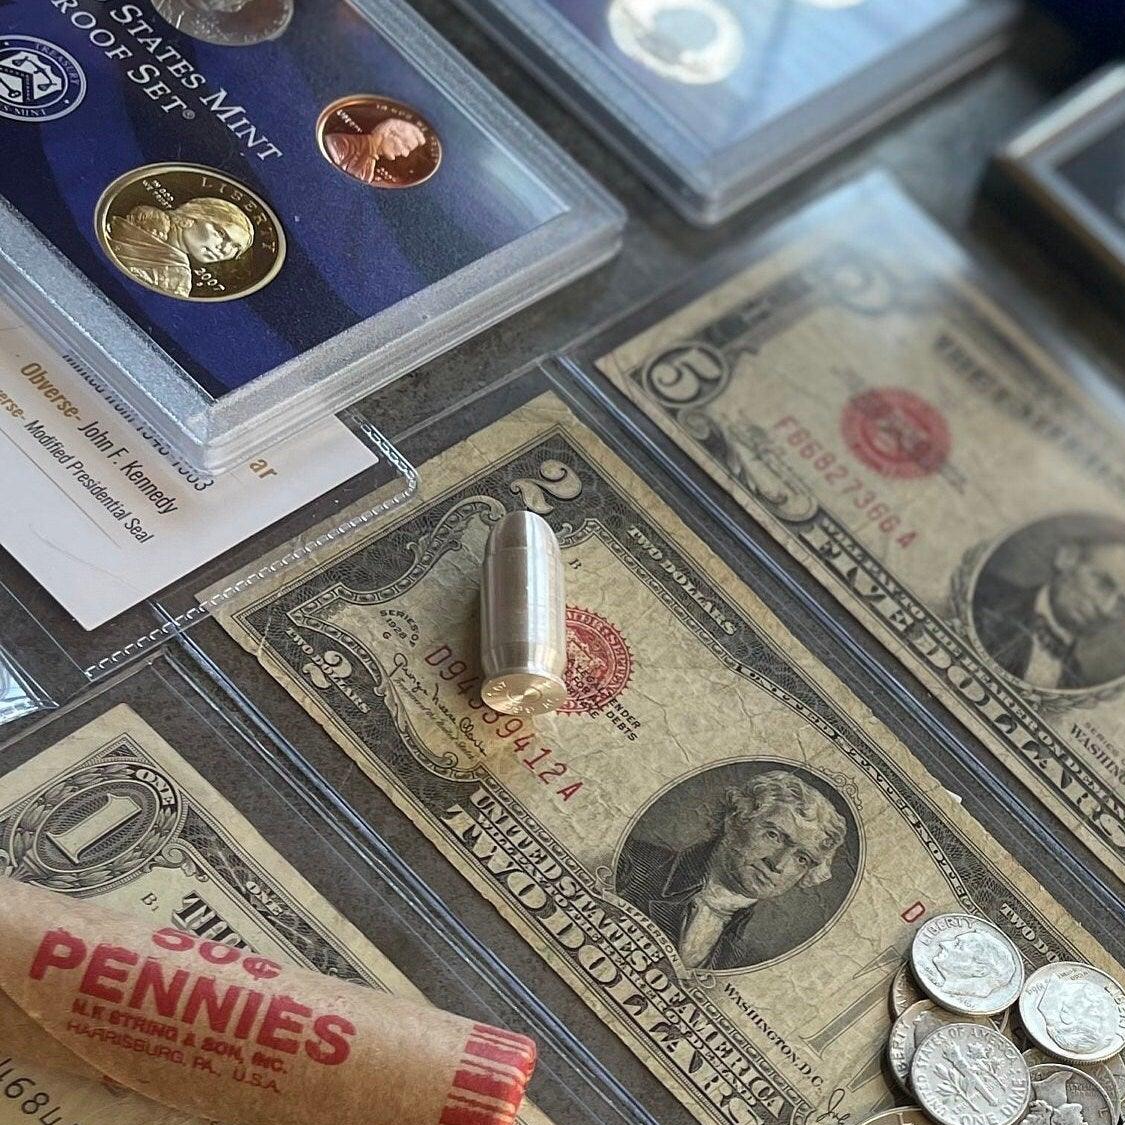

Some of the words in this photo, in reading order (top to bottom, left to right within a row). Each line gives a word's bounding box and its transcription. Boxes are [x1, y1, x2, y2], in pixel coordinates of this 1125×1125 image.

[53, 0, 132, 60] ROOF
[110, 4, 207, 90] STATES
[200, 88, 283, 161] MINT
[194, 267, 225, 292] 2007
[20, 362, 82, 421] Obverse-
[78, 421, 115, 459] John
[107, 447, 130, 465] F.
[120, 460, 178, 515] Kennedy
[25, 419, 70, 465] Modified
[66, 460, 127, 522] Presidential
[124, 517, 153, 544] Seal
[627, 525, 664, 562] TWO
[661, 550, 737, 635] DOLLARS
[798, 520, 915, 635] FIVE
[384, 616, 408, 640] 1928
[605, 709, 638, 742] DEBTS
[136, 768, 175, 807] ONE
[47, 793, 142, 866] 1
[439, 801, 552, 918] TWO
[245, 880, 285, 917] ONE
[618, 896, 682, 968] JEFFERSON
[919, 916, 976, 946] LIBERTY
[467, 784, 565, 885] UNITED
[552, 872, 653, 975] STATES
[641, 963, 684, 1008] OF
[671, 995, 791, 1119] AMERICA
[28, 926, 359, 1066] PENNIES
[106, 1008, 179, 1045] STRING
